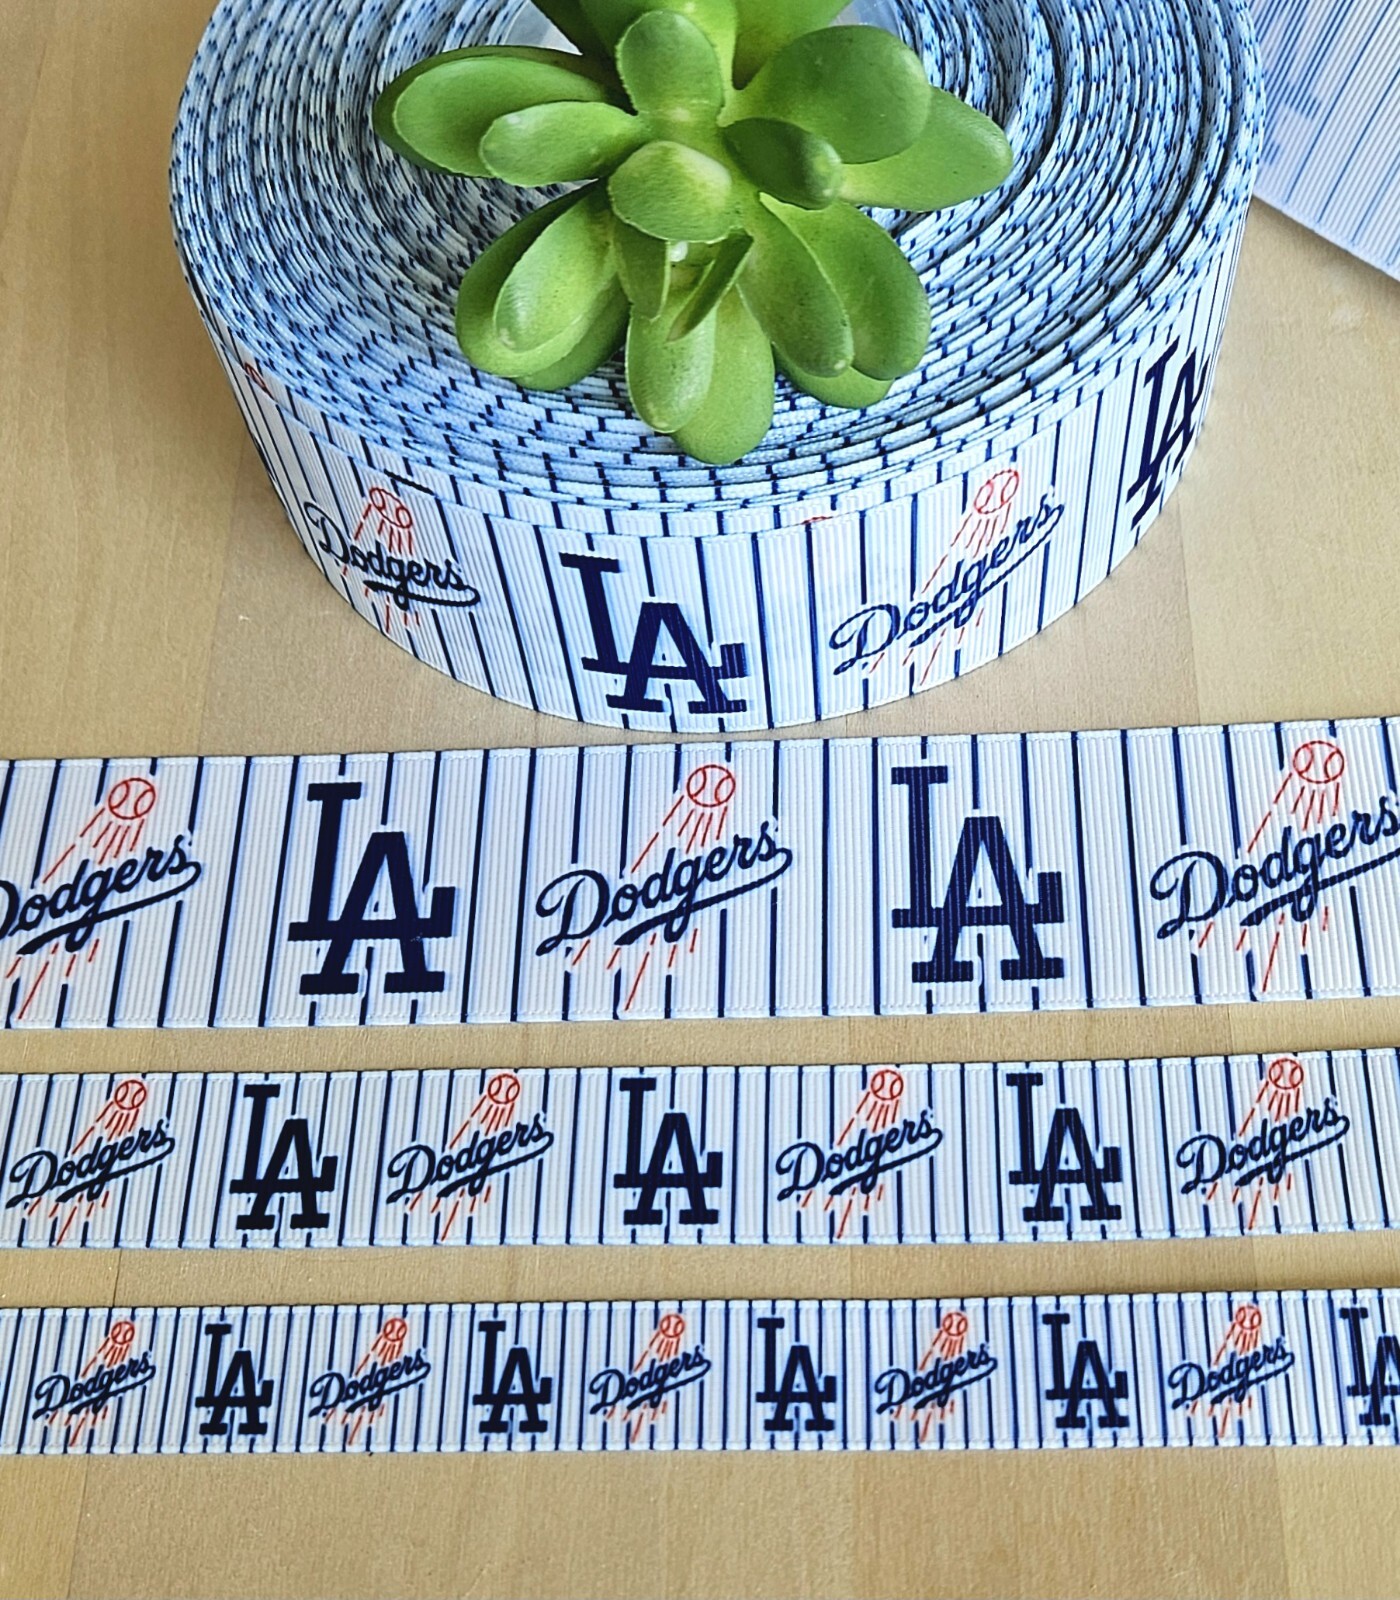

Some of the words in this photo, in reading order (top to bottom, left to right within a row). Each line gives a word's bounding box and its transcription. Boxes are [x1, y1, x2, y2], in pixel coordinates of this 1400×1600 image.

[1125, 335, 1211, 531] LA
[304, 501, 481, 611] Dodgers
[829, 492, 1065, 676] Dodgers
[559, 552, 748, 714] LA
[0, 833, 201, 955] odgers
[288, 782, 456, 996] LA
[536, 820, 793, 956] Dodgers
[891, 765, 1065, 984] LA
[1150, 794, 1400, 940] Dodgers
[6, 1118, 176, 1209] Dodgers
[229, 1083, 339, 1231] LA
[386, 1112, 555, 1205] Dodgers
[613, 1077, 723, 1226] LA
[776, 1109, 944, 1202] Dodgers
[1006, 1072, 1123, 1222] LA
[1176, 1097, 1350, 1195] Dodgers
[32, 1351, 157, 1421] Dodgers
[194, 1323, 275, 1436] LA
[308, 1348, 432, 1418] Dodgers
[472, 1320, 553, 1434] LA
[588, 1345, 712, 1415] Dodgers
[755, 1317, 837, 1432] LA
[874, 1343, 998, 1415] Dodgers
[1042, 1313, 1130, 1429] LA
[1167, 1337, 1295, 1410] Dodgers
